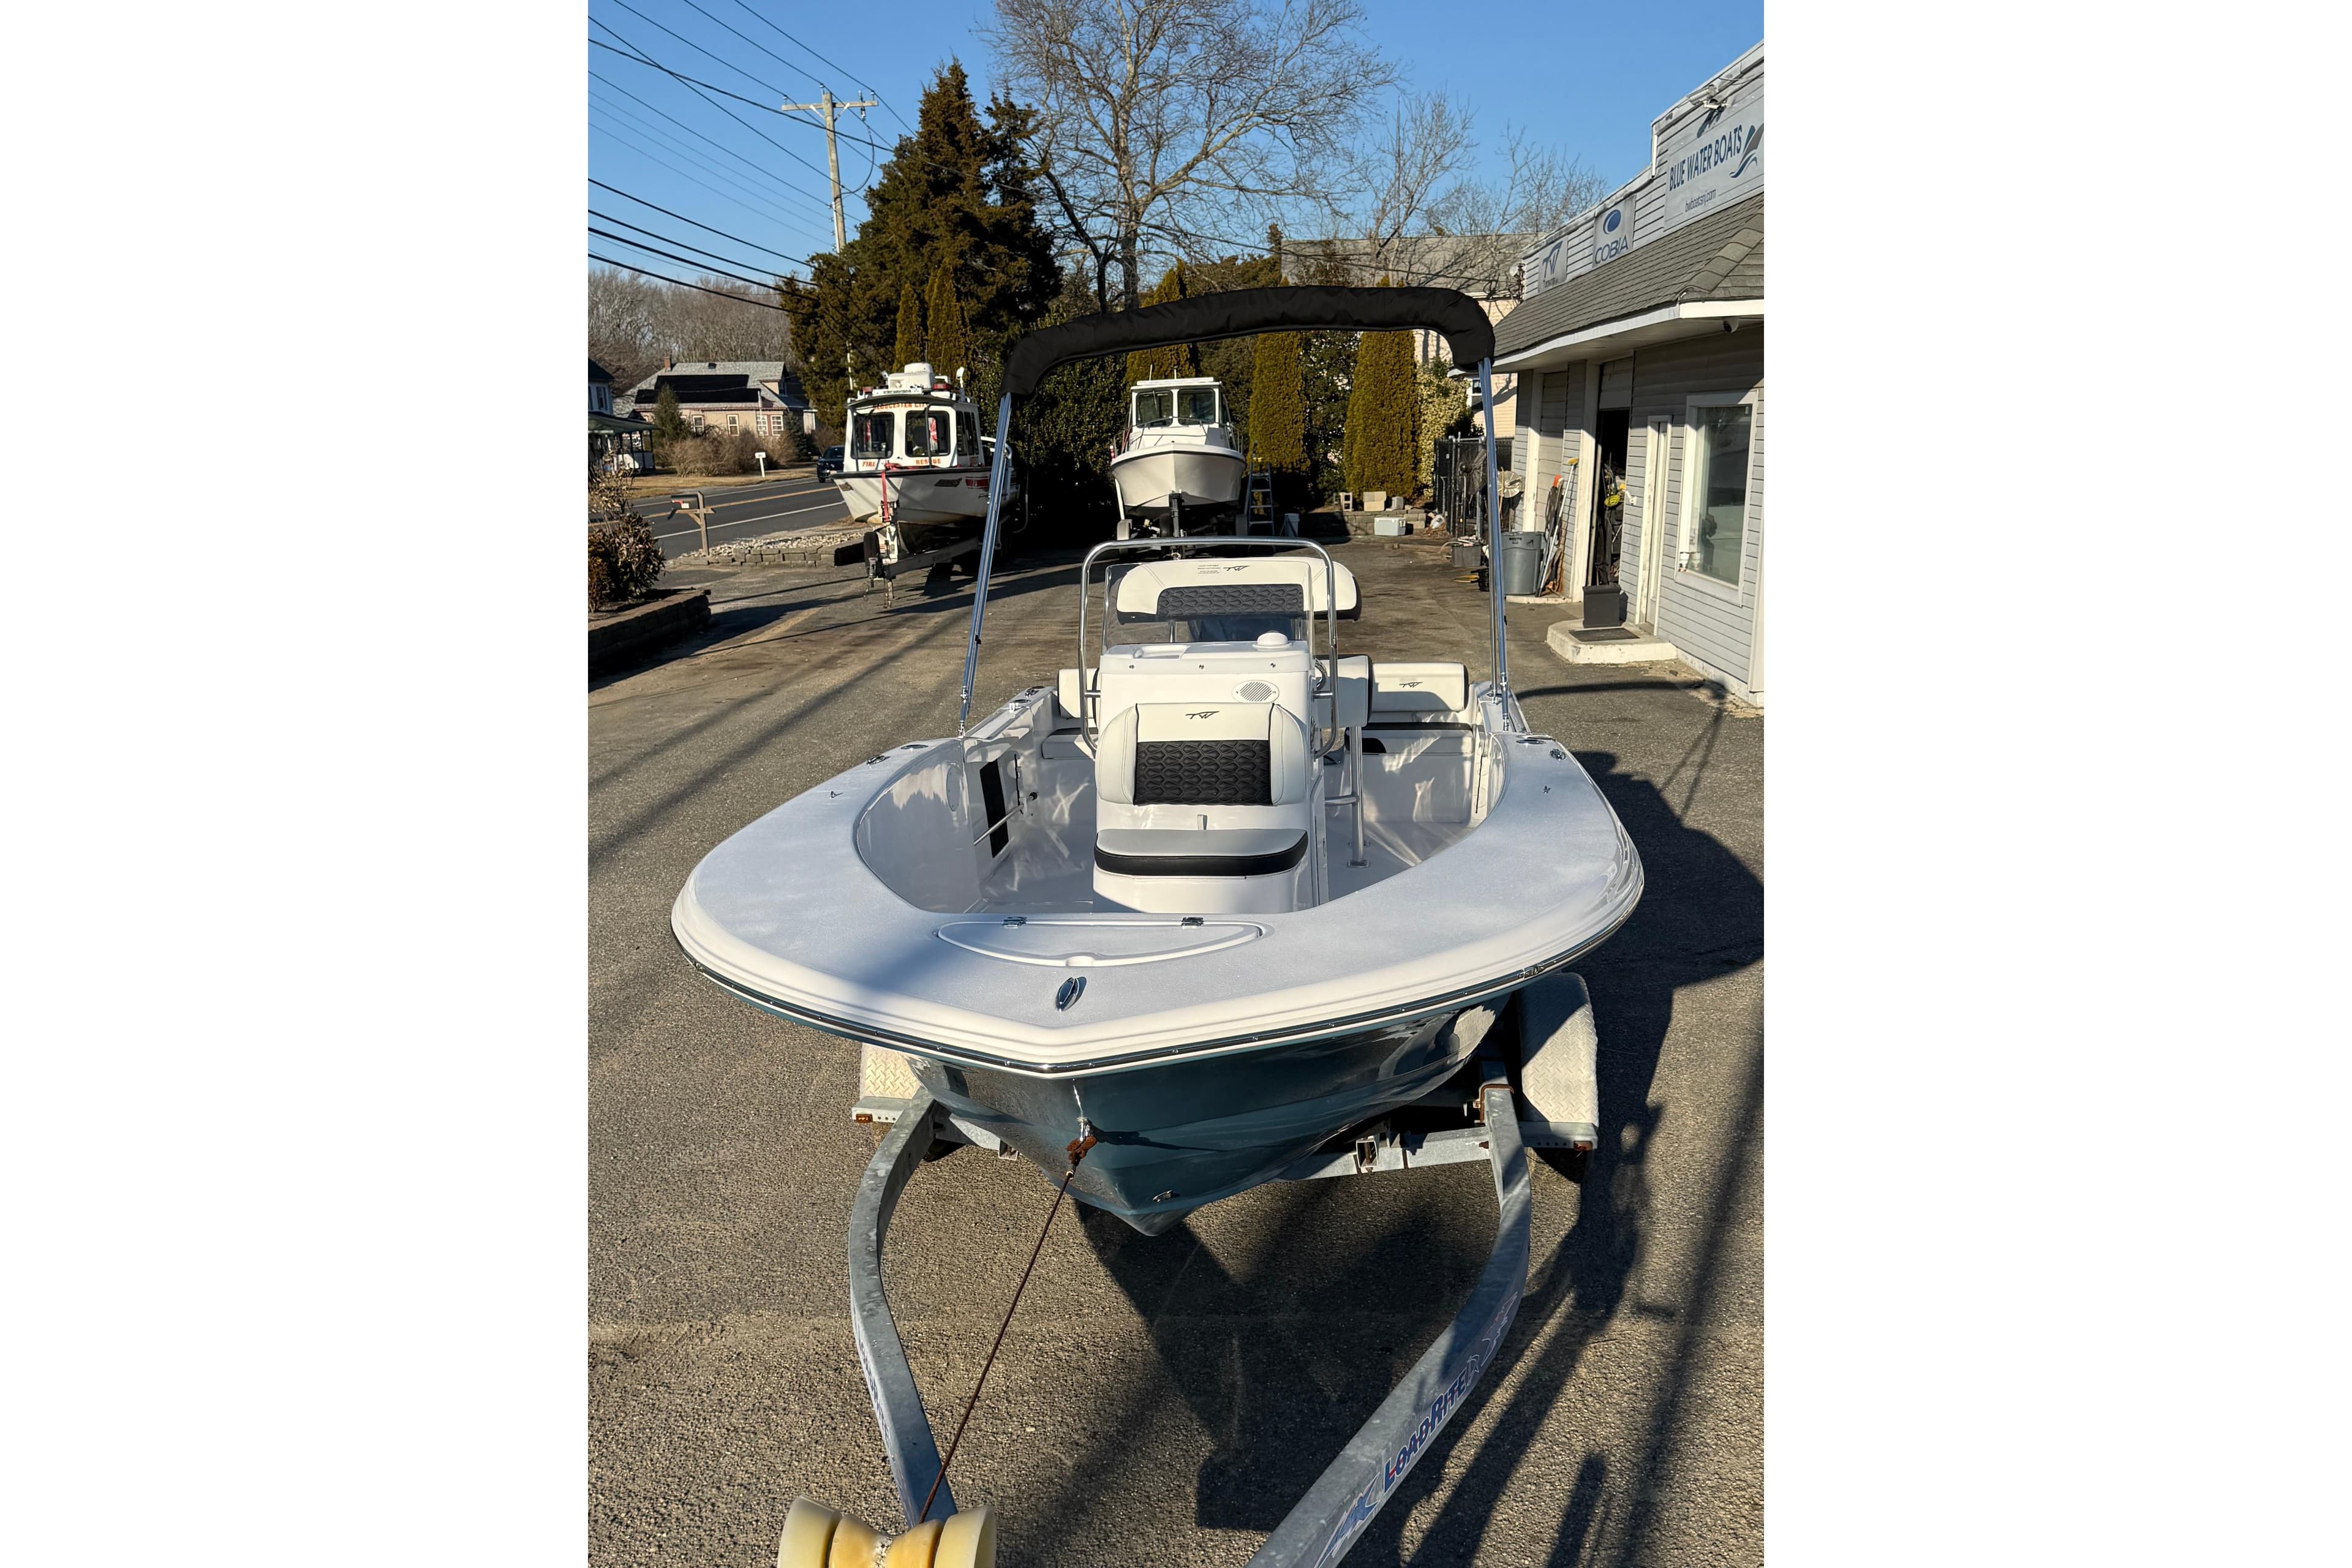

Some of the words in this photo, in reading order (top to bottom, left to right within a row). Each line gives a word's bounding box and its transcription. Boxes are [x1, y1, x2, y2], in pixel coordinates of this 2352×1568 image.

[1669, 159, 1686, 191] BLUE
[1687, 143, 1713, 181] WATER
[1714, 124, 1743, 167] BOATS
[1594, 235, 1629, 265] COBIA
[1383, 1366, 1467, 1495] LOADRITE
